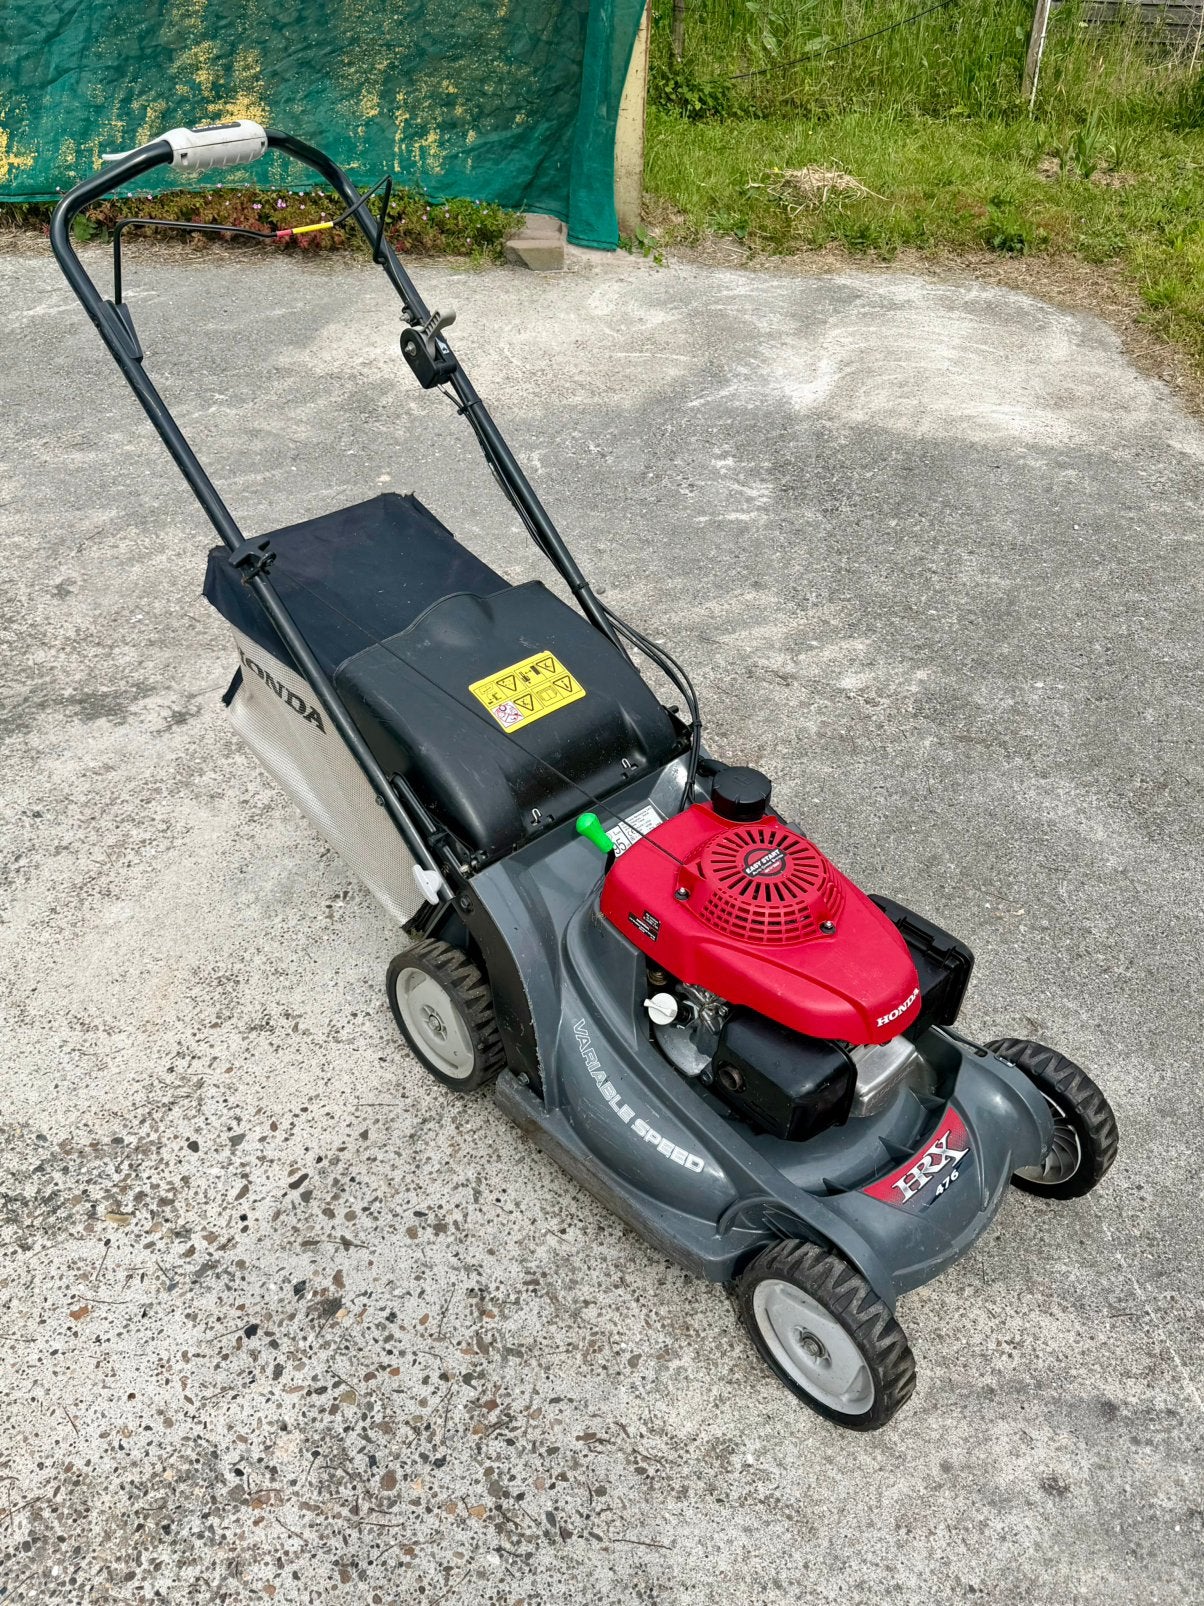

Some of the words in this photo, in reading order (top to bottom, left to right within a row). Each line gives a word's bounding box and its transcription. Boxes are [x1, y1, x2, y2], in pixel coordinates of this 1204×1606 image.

[745, 860, 762, 874] EASY
[760, 849, 780, 864] START
[877, 988, 919, 1027] HONDA
[573, 1018, 636, 1124] VARIABLE
[630, 1118, 705, 1173] SPEED
[891, 1129, 970, 1205] HRX
[935, 1169, 959, 1196] 476
